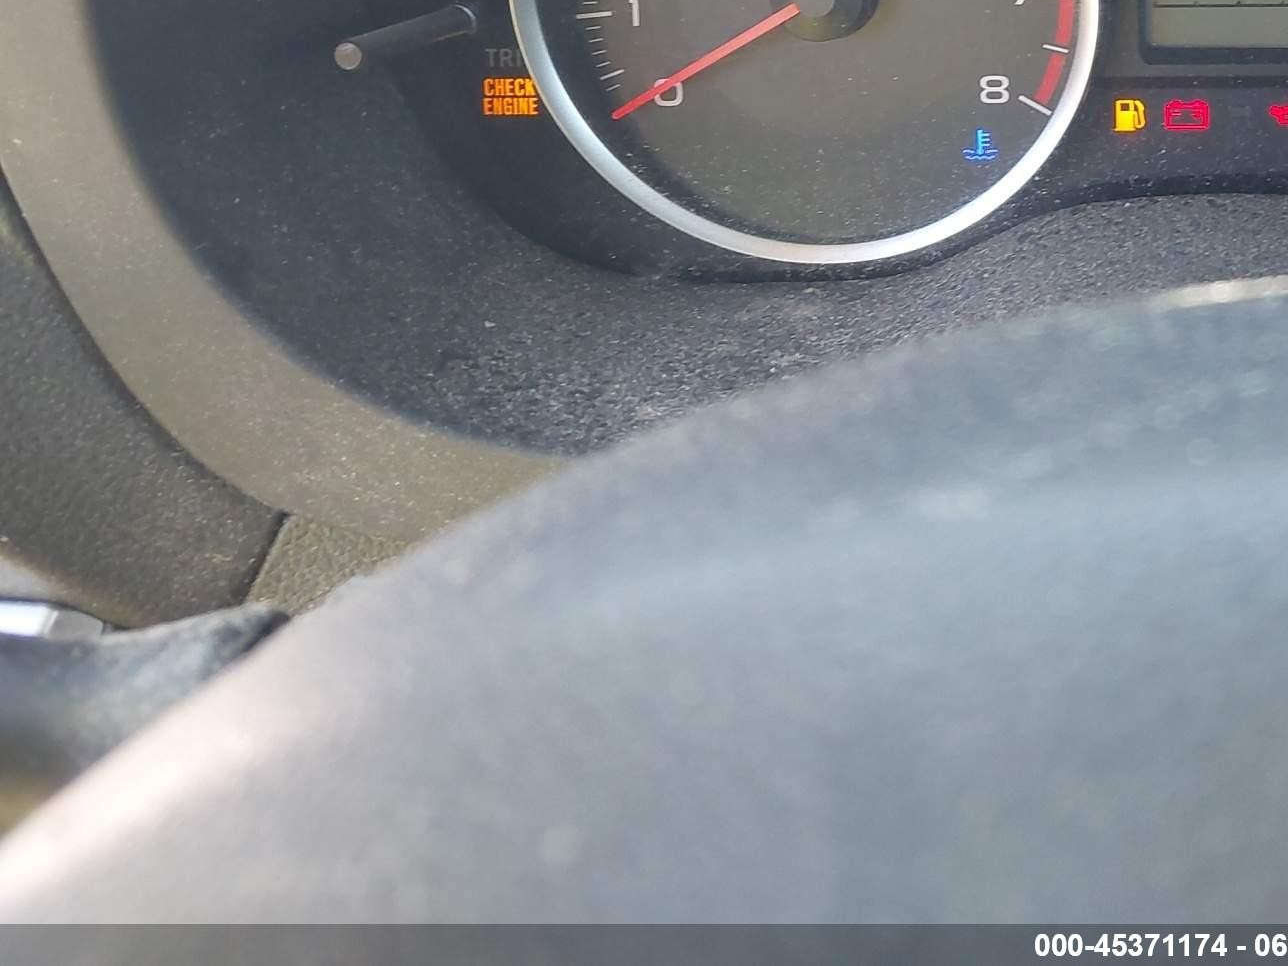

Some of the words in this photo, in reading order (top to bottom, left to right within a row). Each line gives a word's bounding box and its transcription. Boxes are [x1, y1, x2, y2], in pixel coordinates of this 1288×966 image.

[485, 47, 522, 66] TRI
[483, 78, 537, 97] CHECK
[654, 79, 683, 107] 0
[979, 75, 1010, 104] 8
[483, 97, 539, 116] ENGINE
